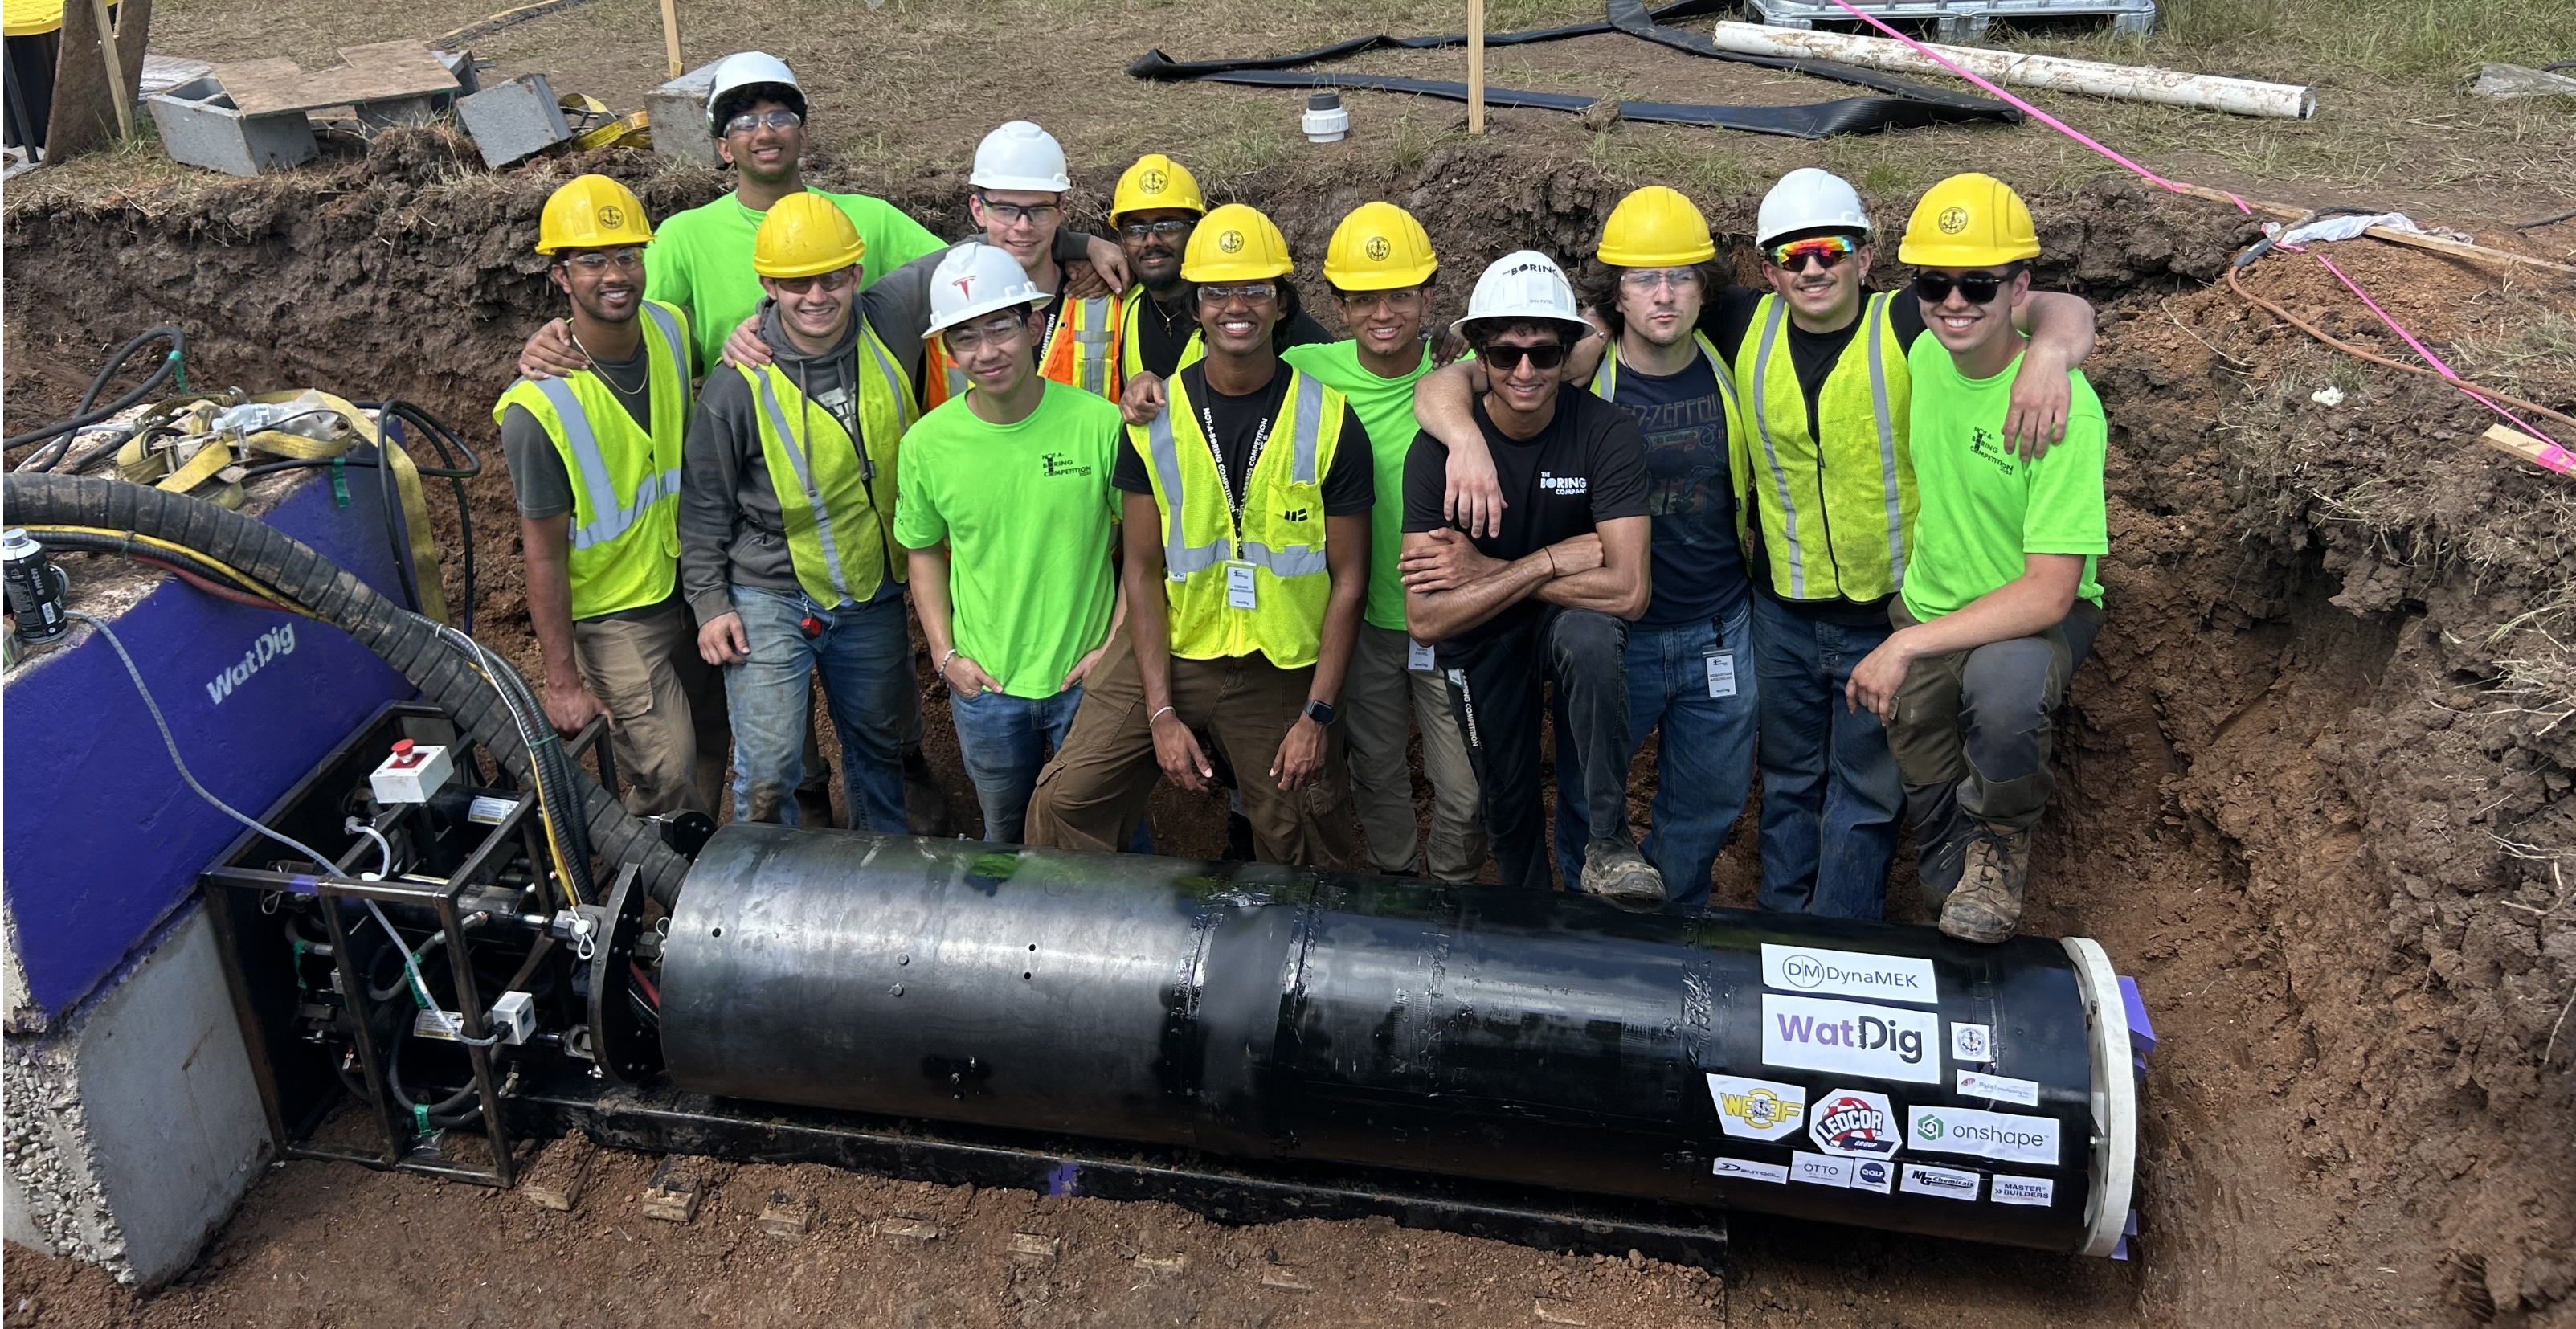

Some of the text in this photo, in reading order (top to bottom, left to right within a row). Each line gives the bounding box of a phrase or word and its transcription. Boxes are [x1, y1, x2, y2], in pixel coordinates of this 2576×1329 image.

[1249, 417, 1268, 467] COMPETITION
[1203, 407, 1236, 513] NOT-A-BORING COMPETITION
[1540, 477, 1587, 489] BORING
[206, 622, 295, 705] WatDig
[1465, 703, 1479, 747] COMPETITION
[1826, 967, 1919, 988] DynaMEK
[1777, 1013, 1923, 1064] WatDig
[1816, 1110, 1883, 1141] LEDCOR
[1854, 1140, 1878, 1149] GROUP
[1803, 1163, 1838, 1176] OTTO
[1912, 1169, 1973, 1187] MG Chemicals
[2003, 1189, 2049, 1199] BUILDERS
